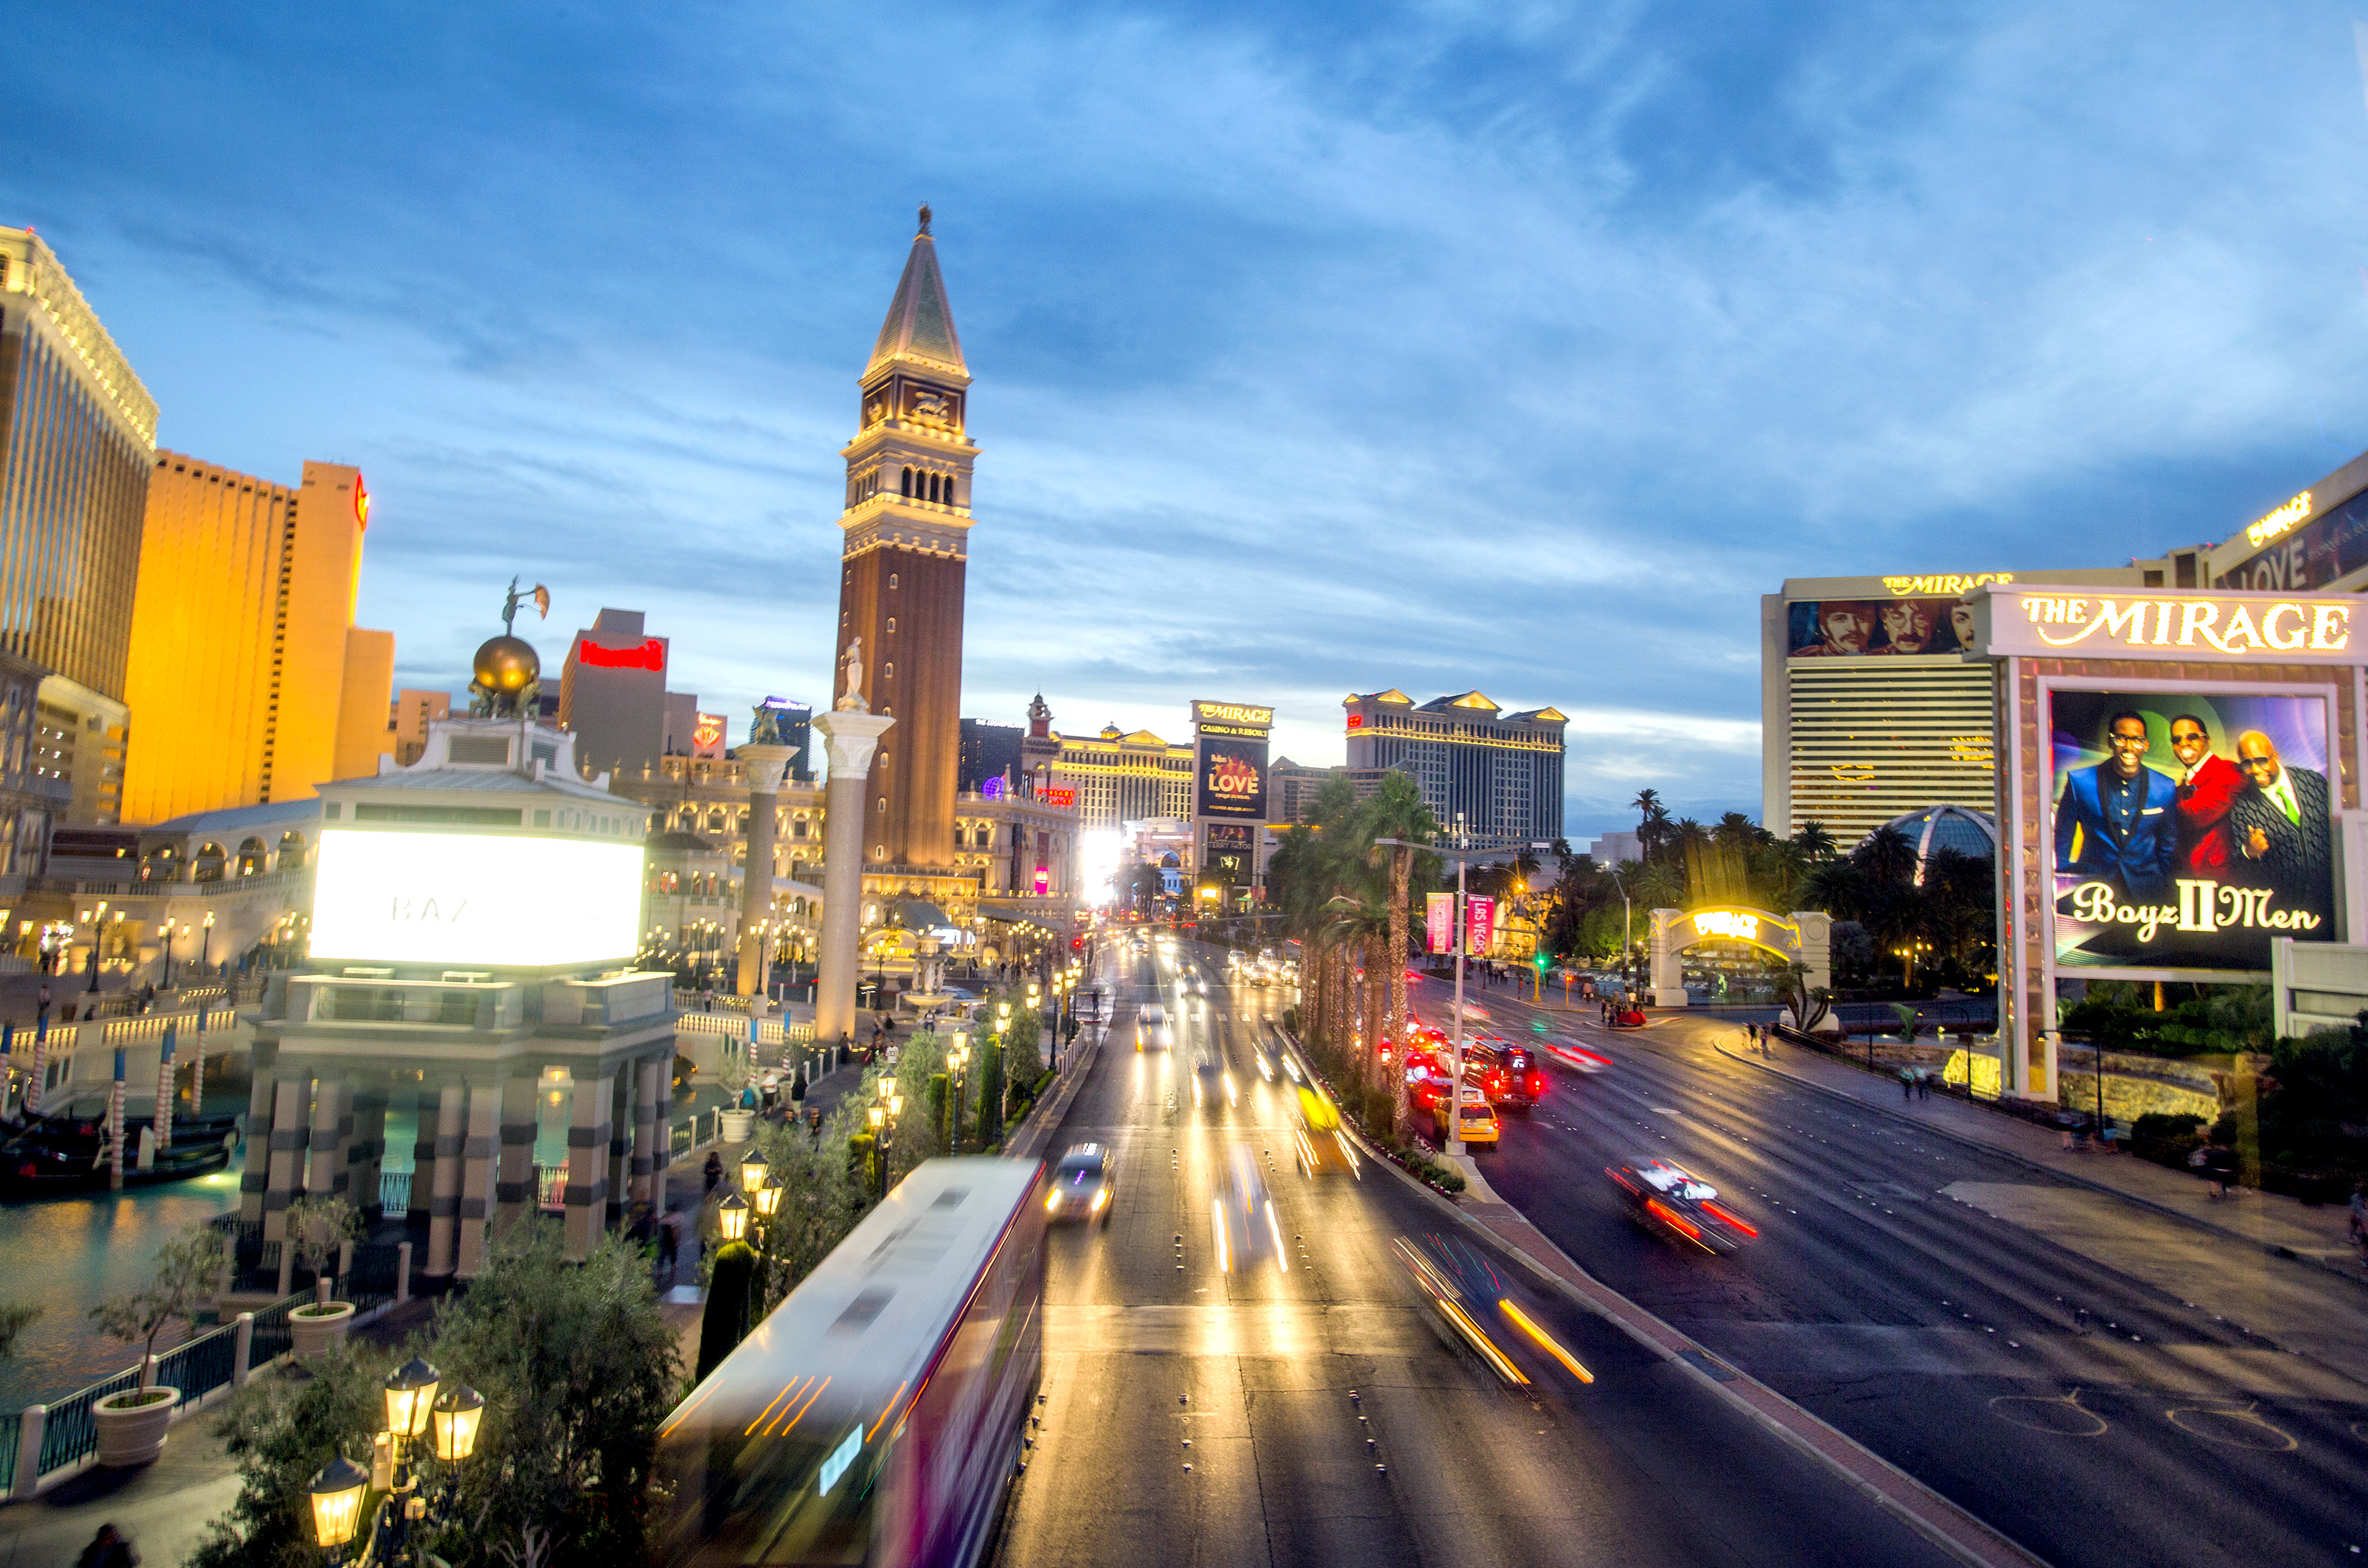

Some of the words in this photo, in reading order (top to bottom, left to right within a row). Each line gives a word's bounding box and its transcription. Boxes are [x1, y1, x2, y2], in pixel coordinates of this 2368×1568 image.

[2021, 598, 2088, 624] THE
[2037, 598, 2351, 654] MIRAGE
[1202, 705, 1272, 723] MIRAGE
[1200, 724, 1231, 734] CASINO
[1238, 728, 1268, 737] RESORT
[1208, 773, 1259, 794] LOVE
[1434, 901, 1447, 931] VEGAS
[1474, 903, 1487, 921] LAS
[2073, 882, 2179, 942] Boyz
[2176, 878, 2219, 932] II
[2216, 885, 2321, 929] Men
[1434, 933, 1447, 952] LAS
[1473, 922, 1487, 952] VEGAS
